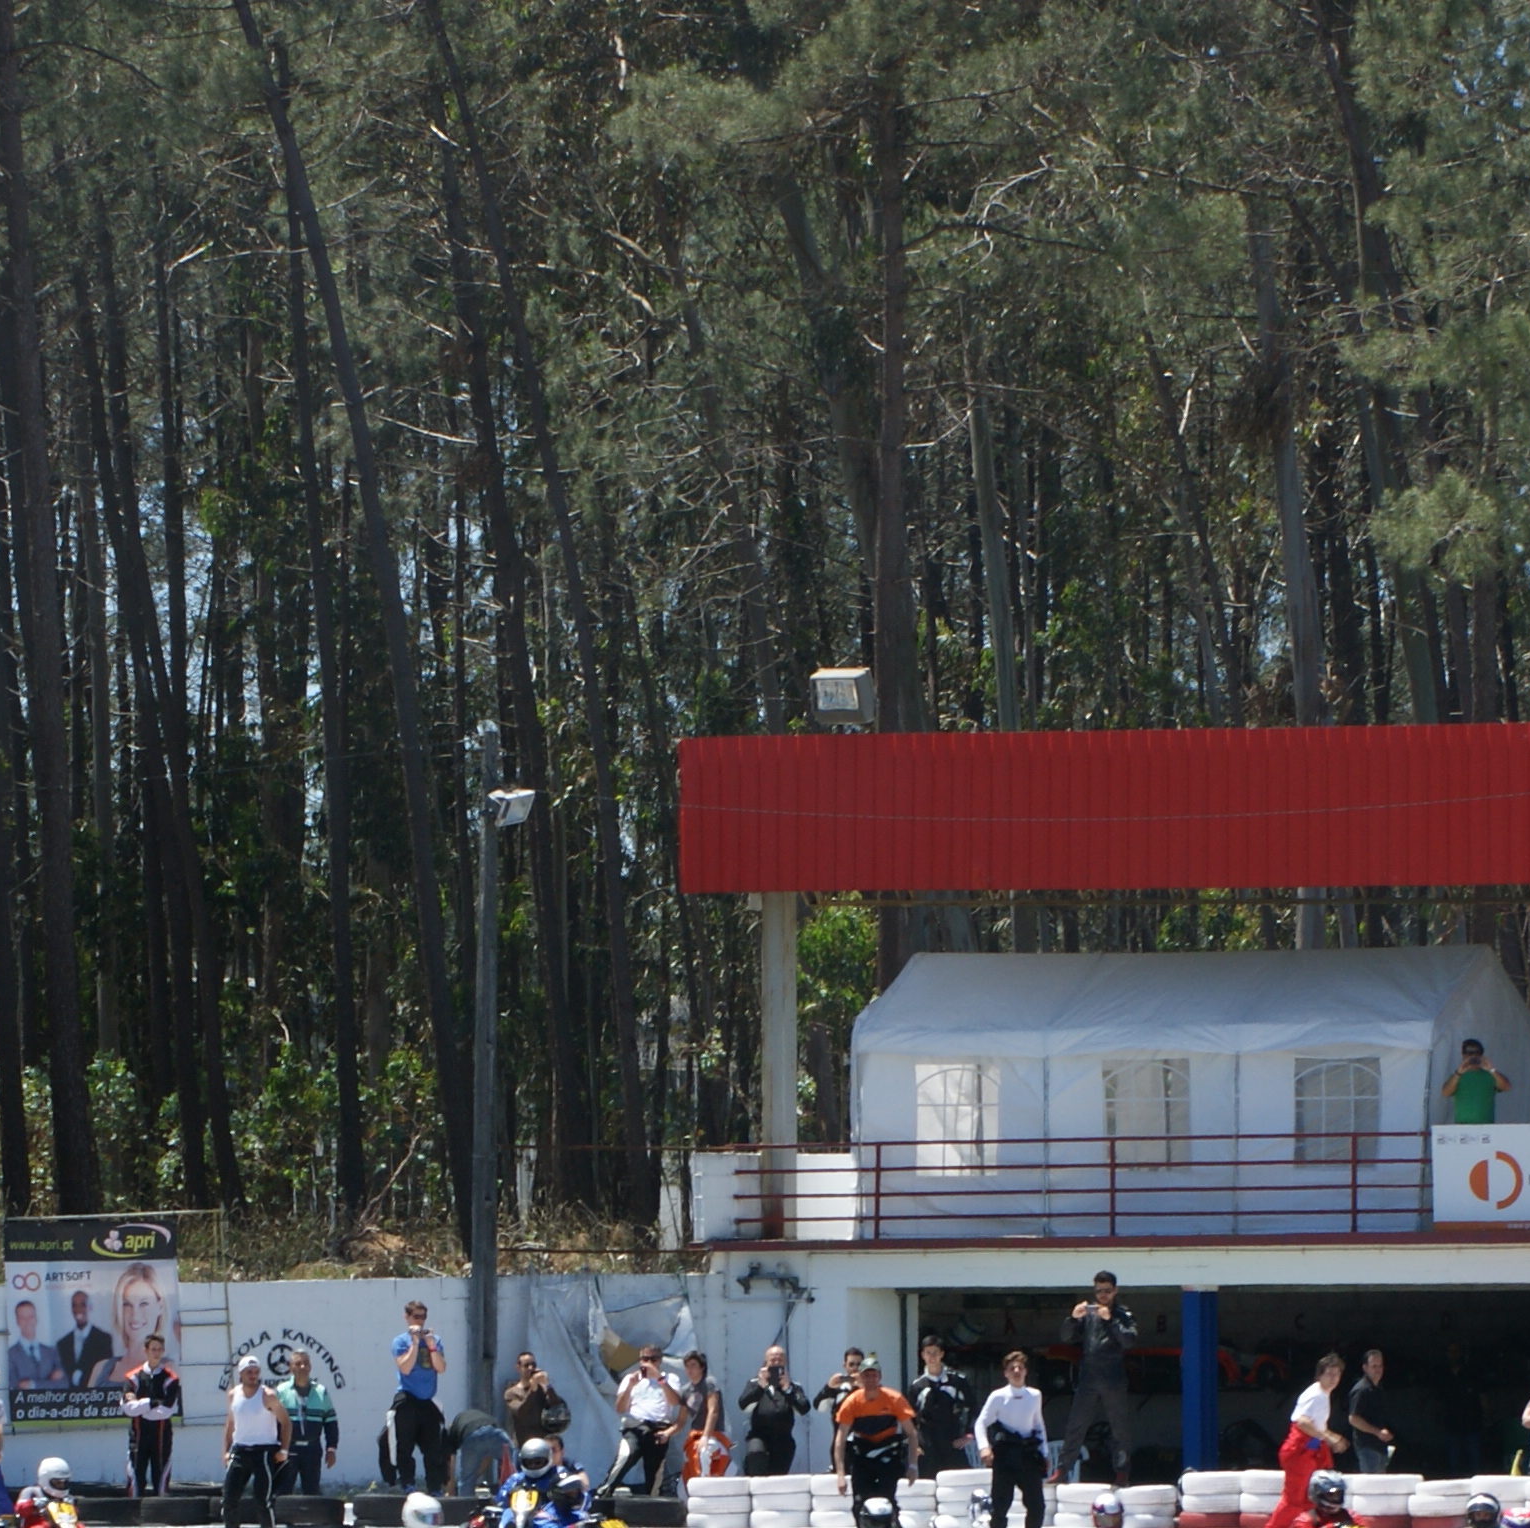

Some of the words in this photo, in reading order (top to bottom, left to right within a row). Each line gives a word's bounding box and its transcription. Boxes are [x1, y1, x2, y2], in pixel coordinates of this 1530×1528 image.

[9, 1239, 74, 1252] www.apri.pt
[124, 1231, 156, 1252] apri
[44, 1270, 92, 1282] ARTSOFT
[1003, 1311, 1016, 1334] A
[282, 1327, 346, 1390] KARTING
[15, 1391, 25, 1403] A
[27, 1390, 66, 1402] melhor
[69, 1390, 104, 1405] opção
[16, 1409, 25, 1419] o
[27, 1406, 80, 1418] dia-a-dia
[83, 1405, 99, 1417] da
